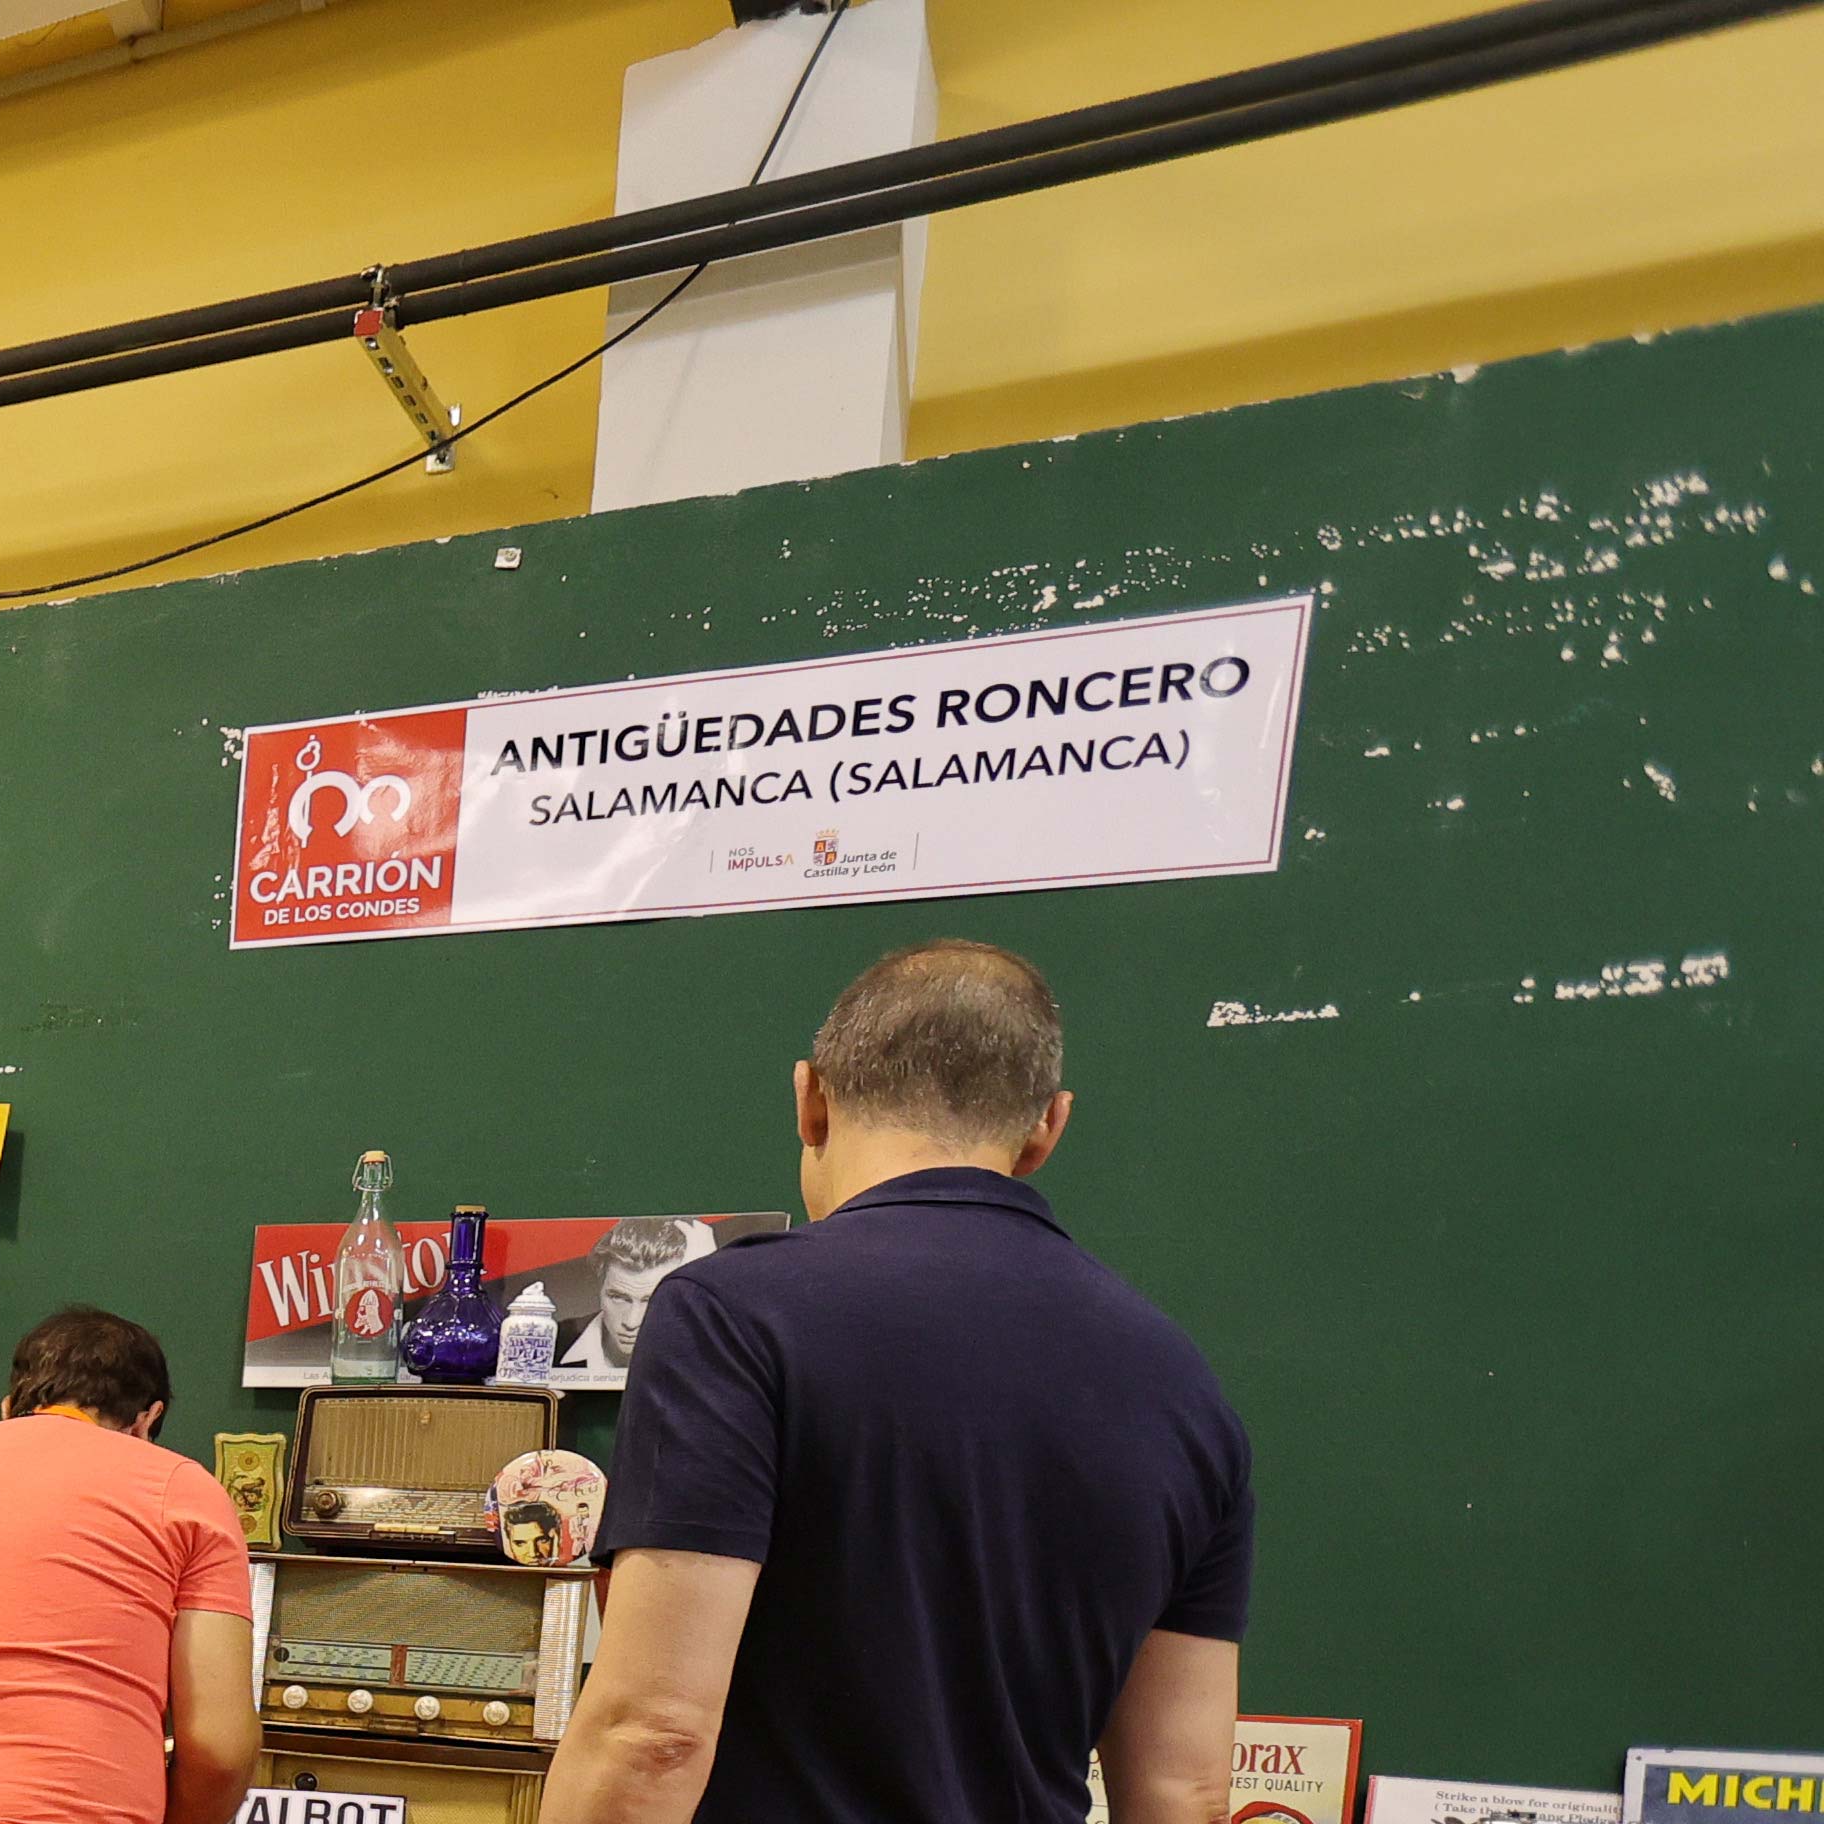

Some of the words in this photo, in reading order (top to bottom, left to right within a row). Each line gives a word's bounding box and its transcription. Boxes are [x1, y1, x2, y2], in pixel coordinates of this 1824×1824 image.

[489, 690, 916, 778] ANTIGÜEDADES
[935, 655, 1251, 730] RONCERO
[527, 768, 815, 828] SALAMANCA
[829, 728, 1192, 806] (SALAMANCA)
[840, 853, 877, 865] Junta
[880, 850, 897, 861] de
[250, 850, 442, 904] CARRIÓN
[803, 866, 849, 878] Castilla
[851, 866, 860, 877] y
[863, 862, 896, 874] León
[263, 908, 290, 926] DE
[294, 904, 332, 923] LOS
[335, 897, 420, 919] CONDES
[1264, 1778, 1325, 1793] QUALITY
[1435, 1790, 1478, 1803] Strike
[1492, 1795, 1526, 1806] blow
[1528, 1798, 1549, 1809] for
